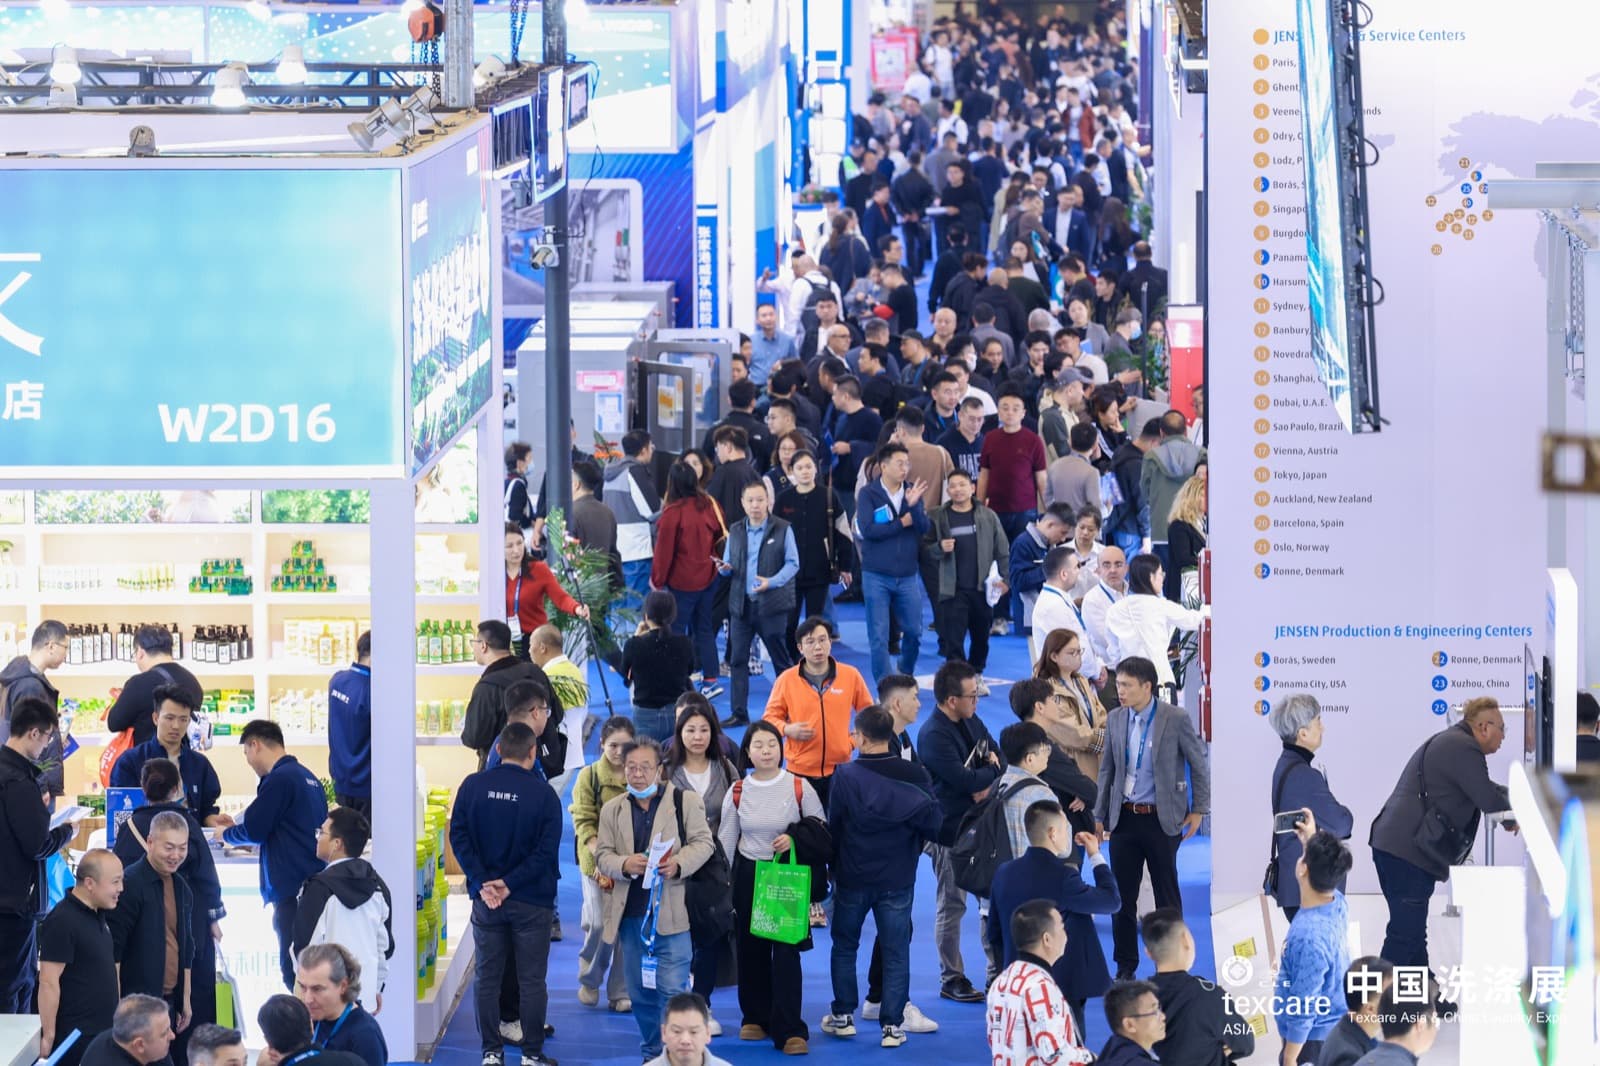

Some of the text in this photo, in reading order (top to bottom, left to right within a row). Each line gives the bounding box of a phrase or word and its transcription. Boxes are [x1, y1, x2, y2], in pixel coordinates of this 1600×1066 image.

[1369, 28, 1416, 41] Service
[1418, 29, 1466, 41] Centers
[1273, 58, 1296, 67] Paris,
[1273, 131, 1296, 141] Odry,
[1273, 156, 1295, 166] Lodz,
[1273, 204, 1306, 215] Singapo
[1273, 253, 1308, 262] Panama
[1273, 277, 1308, 287] Harsum,
[1273, 301, 1306, 312] Sydney,
[1273, 373, 1315, 383] Shanghai,
[2, 380, 44, 420] 店
[1273, 398, 1300, 408] Dubai,
[1303, 398, 1327, 407] U.A.E.
[158, 402, 336, 443] W2D16
[1273, 422, 1289, 431] Sao
[1291, 422, 1317, 432] Paulo,
[1319, 422, 1343, 431] Brazil
[1273, 446, 1306, 456] Vienna,
[1308, 446, 1338, 455] Austria
[1274, 471, 1300, 481] Tokyo,
[1303, 471, 1327, 480] Japan
[1273, 494, 1315, 504] Auckland,
[1318, 494, 1337, 503] New
[1338, 494, 1372, 503] Zealand
[1274, 519, 1318, 528] Barcelona,
[1320, 519, 1344, 528] Spain
[1274, 543, 1294, 552] Oslo,
[1296, 543, 1329, 553] Norway
[1305, 566, 1344, 576] Denmark
[1275, 624, 1533, 640] JENSEN Production & Engineering Centers
[1302, 656, 1336, 664] Sweden
[1483, 655, 1523, 664] Denmark
[1274, 680, 1308, 688] Panama
[1310, 680, 1328, 690] City,
[1330, 680, 1346, 688] USA
[1451, 680, 1485, 689] Xuzhou,
[1486, 680, 1510, 688] China
